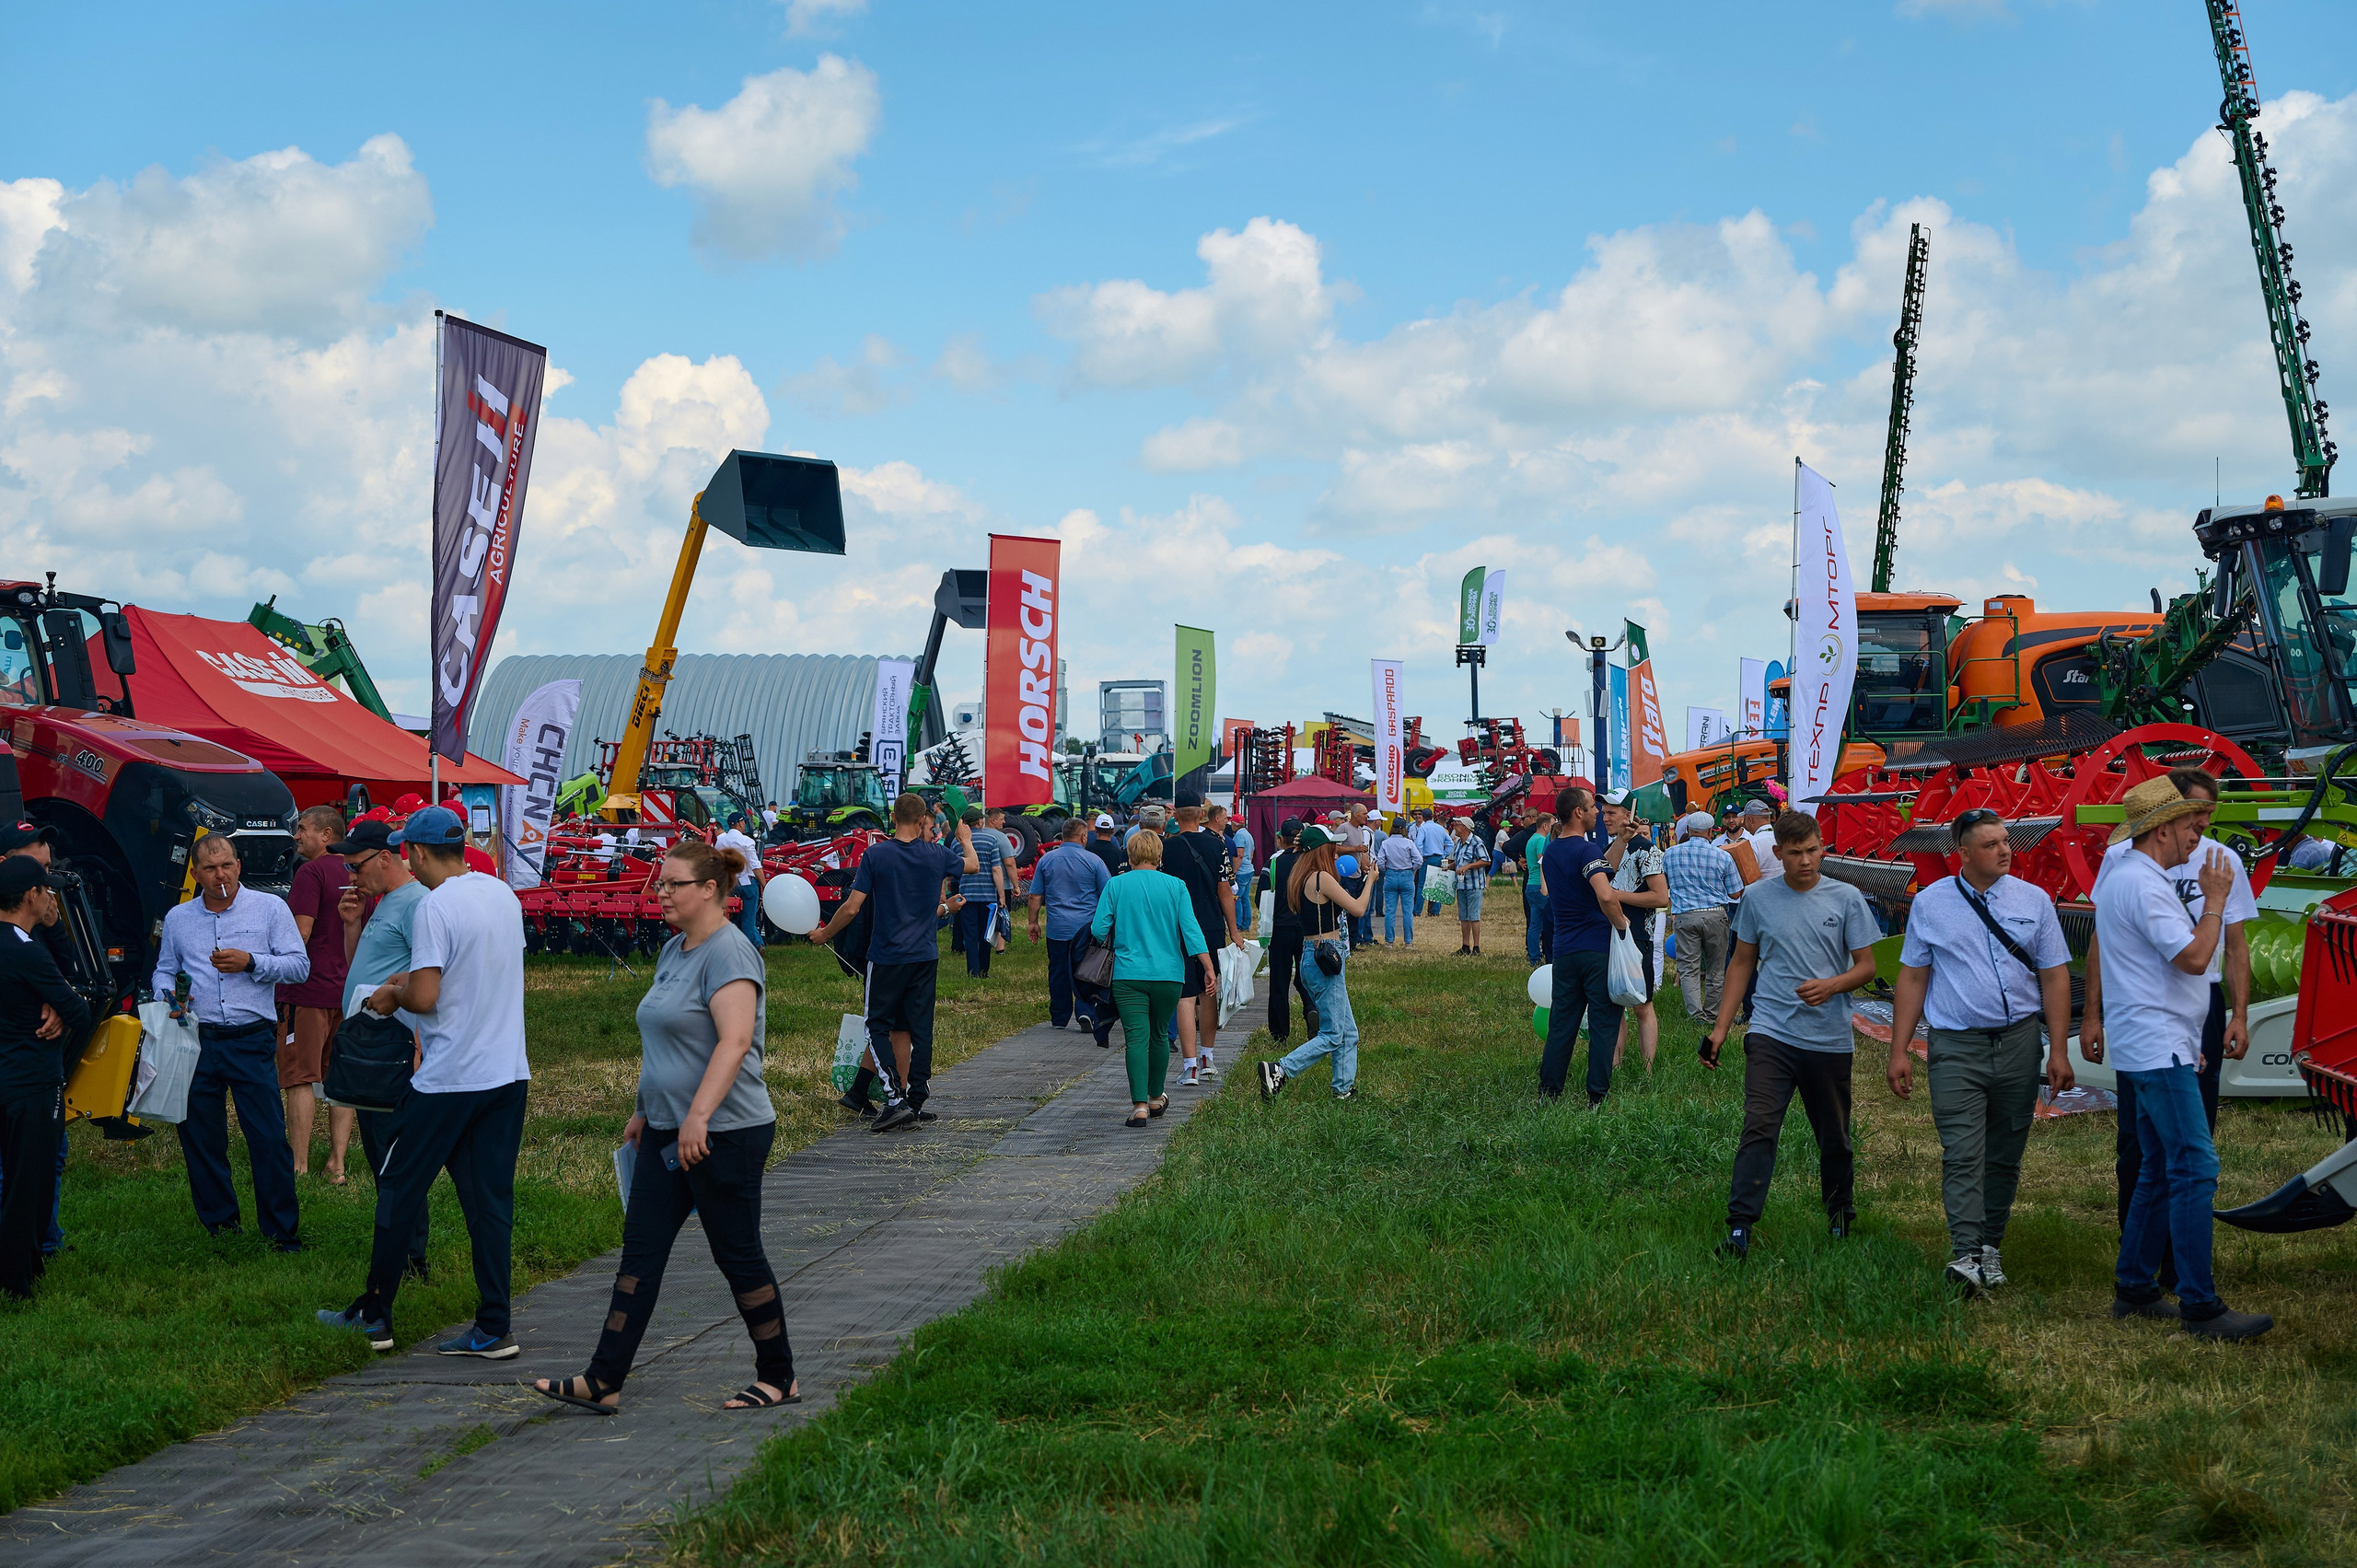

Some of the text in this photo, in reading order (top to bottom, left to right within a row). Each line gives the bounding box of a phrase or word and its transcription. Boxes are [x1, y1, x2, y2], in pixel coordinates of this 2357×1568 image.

[490, 421, 525, 585] AGRICULTURE
[439, 462, 502, 707] CASE
[195, 649, 291, 684] CASE
[1019, 569, 1052, 782] HORSCH
[880, 687, 888, 735] БРЯНСКИЙ
[888, 675, 897, 735] ТРАКТОРНЫЙ
[1188, 648, 1202, 749] ZOOMLION
[512, 746, 522, 768] your
[517, 717, 530, 744] Make
[1385, 668, 1397, 796] MASCHIO GASPARDO
[75, 749, 104, 773] 400
